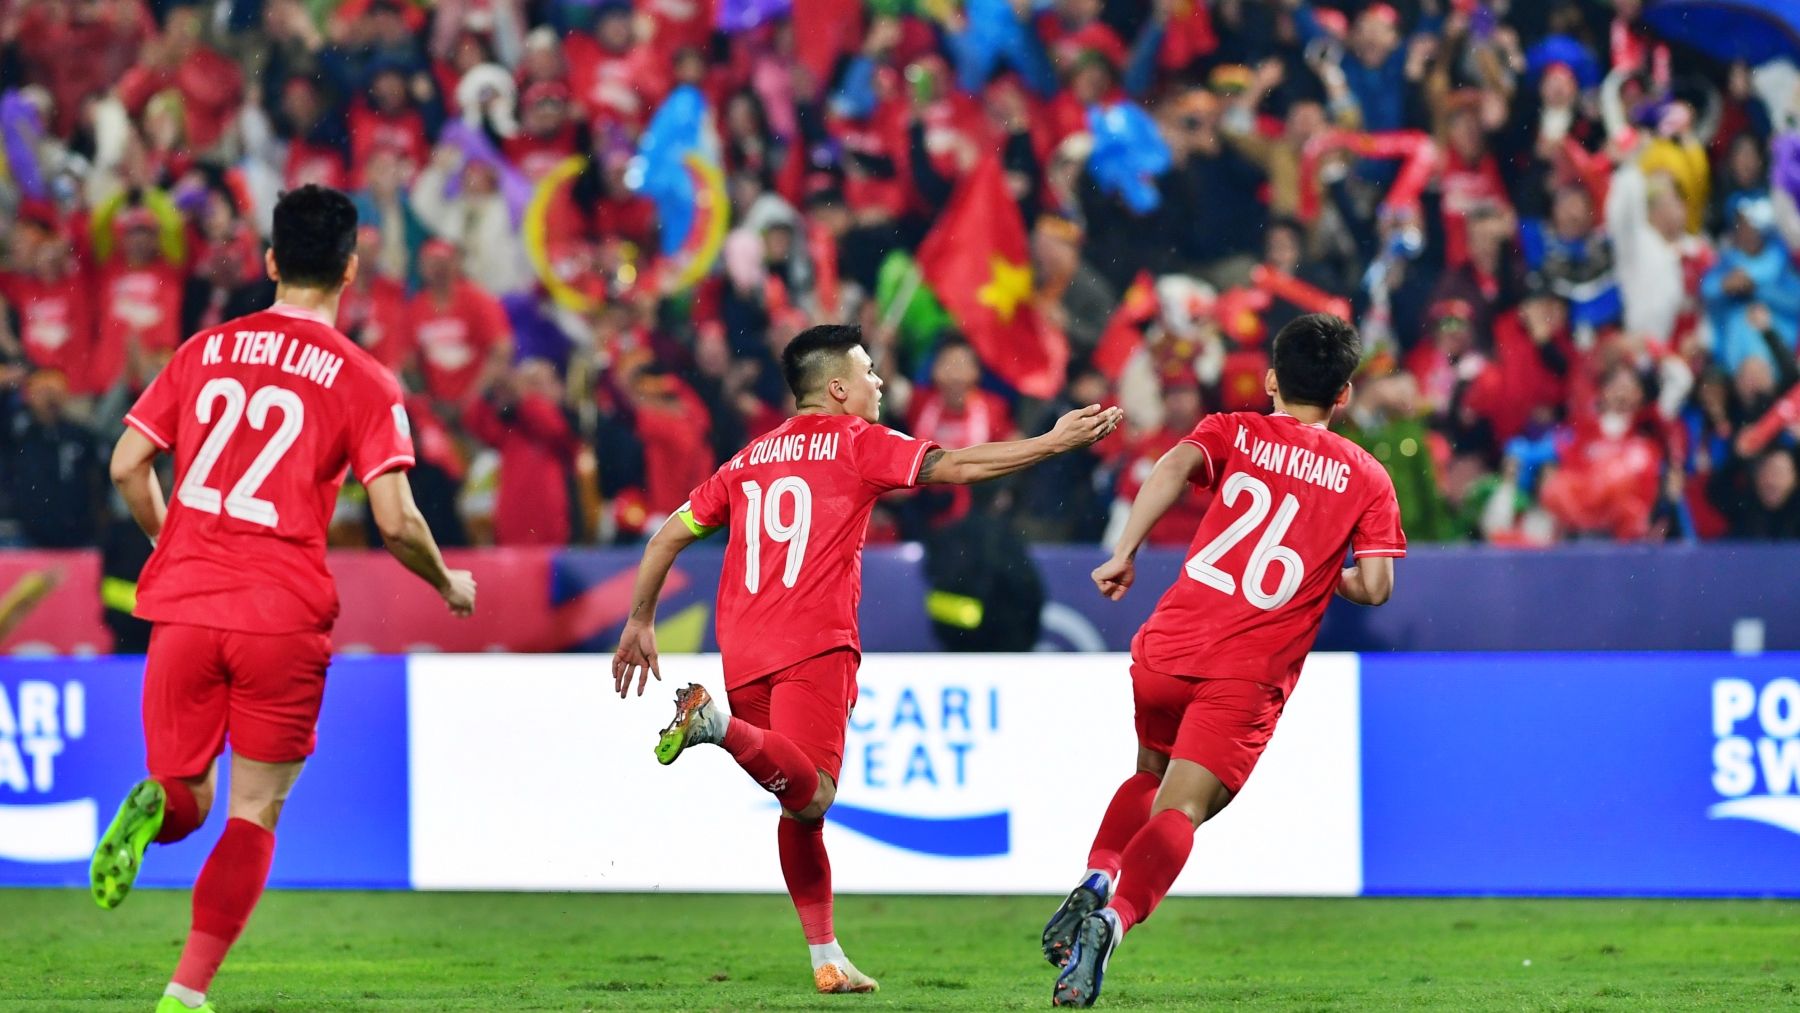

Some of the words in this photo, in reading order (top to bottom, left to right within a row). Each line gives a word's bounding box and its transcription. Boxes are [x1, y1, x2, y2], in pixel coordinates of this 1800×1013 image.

[202, 333, 224, 366] N.
[230, 331, 285, 366] TIEN
[281, 338, 344, 389] LINH
[177, 377, 304, 528] 22
[749, 434, 805, 466] QUANG
[808, 432, 840, 461] HAI
[1233, 424, 1250, 455] K.
[1251, 436, 1288, 474] VAN
[1286, 446, 1351, 494] KHANG
[741, 475, 812, 595] 19
[1185, 471, 1305, 611] 26
[1711, 678, 1800, 738] PO
[840, 742, 976, 788] EAT
